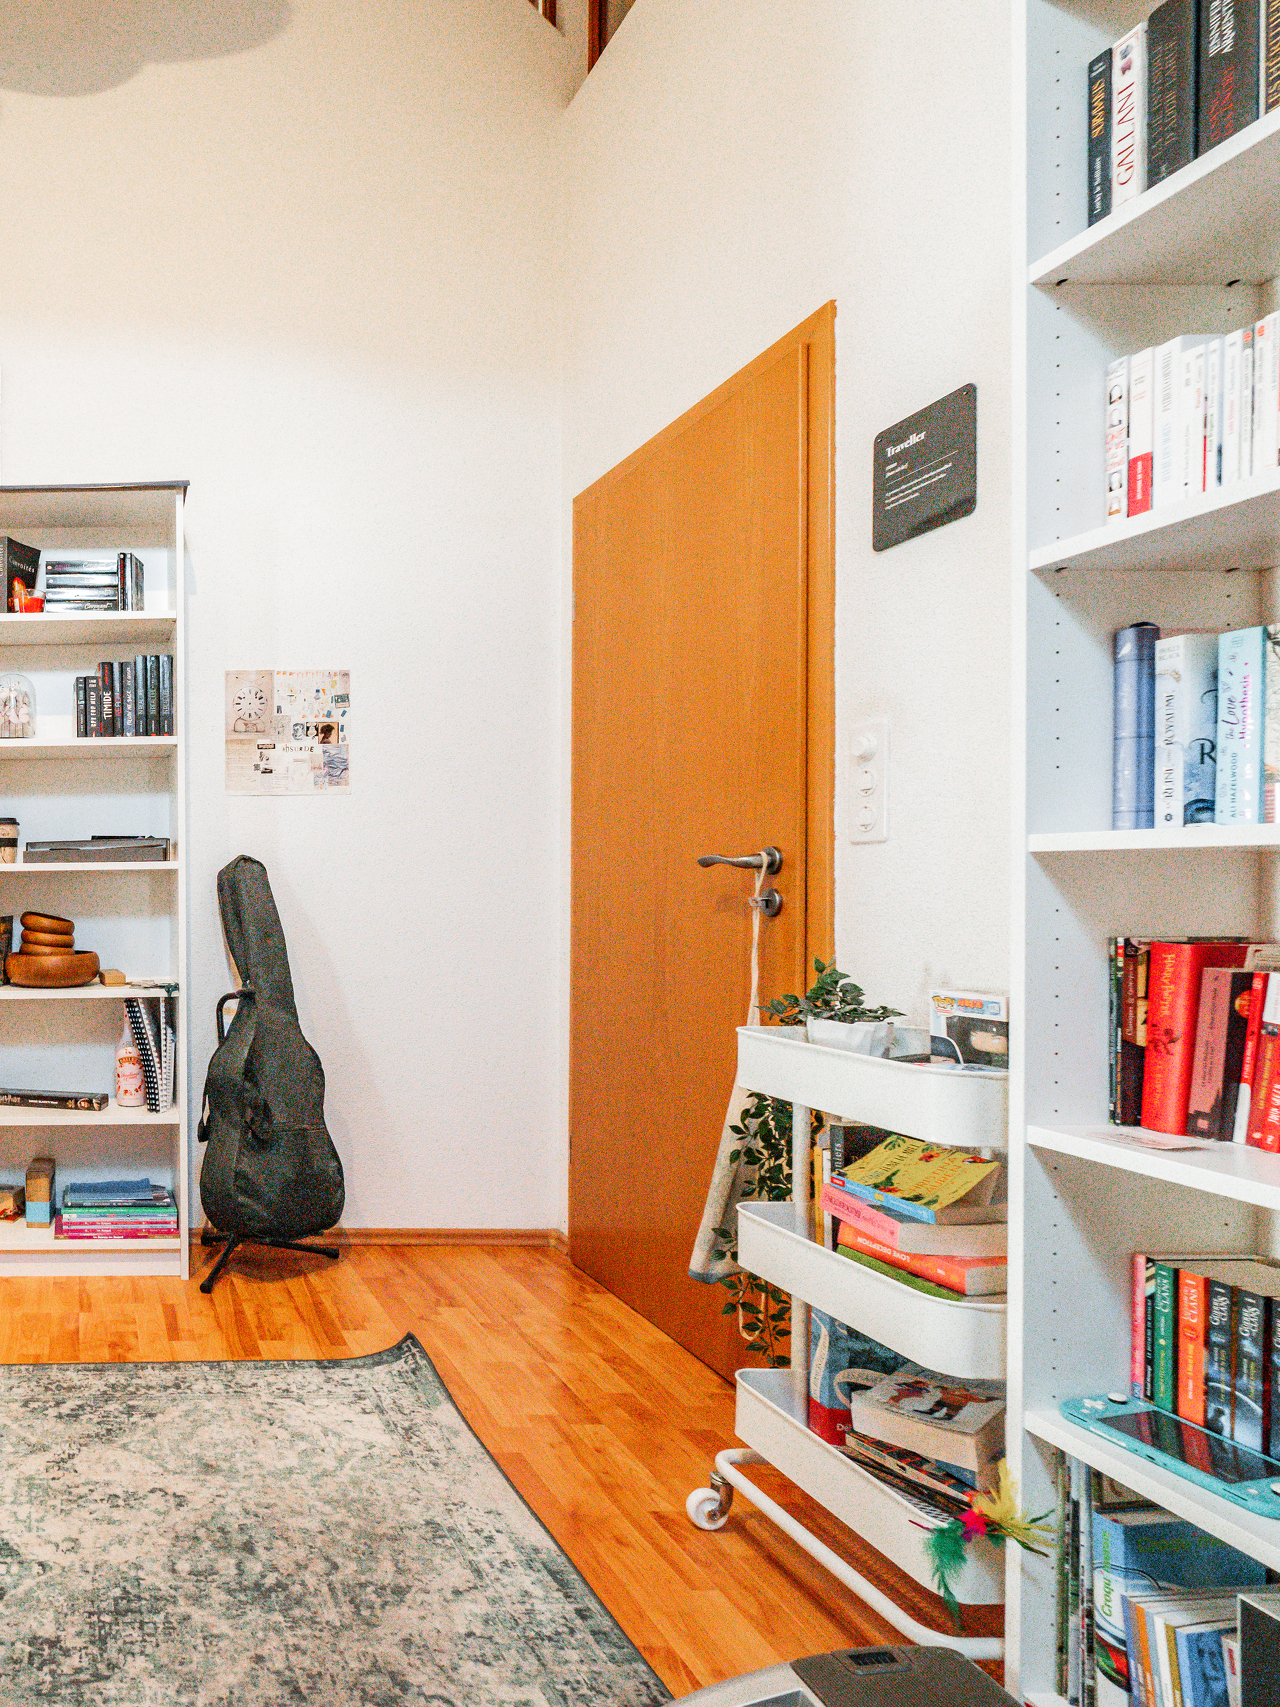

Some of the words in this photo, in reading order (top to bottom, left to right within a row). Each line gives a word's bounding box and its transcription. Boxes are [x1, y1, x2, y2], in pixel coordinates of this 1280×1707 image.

[1091, 76, 1104, 140] SURVIVANTS
[1116, 76, 1134, 188] GALLANT
[886, 431, 926, 458] Traveller
[102, 691, 112, 720] TIMIDE
[1221, 694, 1239, 727] Love
[1229, 751, 1237, 803] HAZELWOOD
[1229, 805, 1237, 818] ALI
[857, 1237, 892, 1256] DECEPTION
[892, 1251, 910, 1263] LOVE
